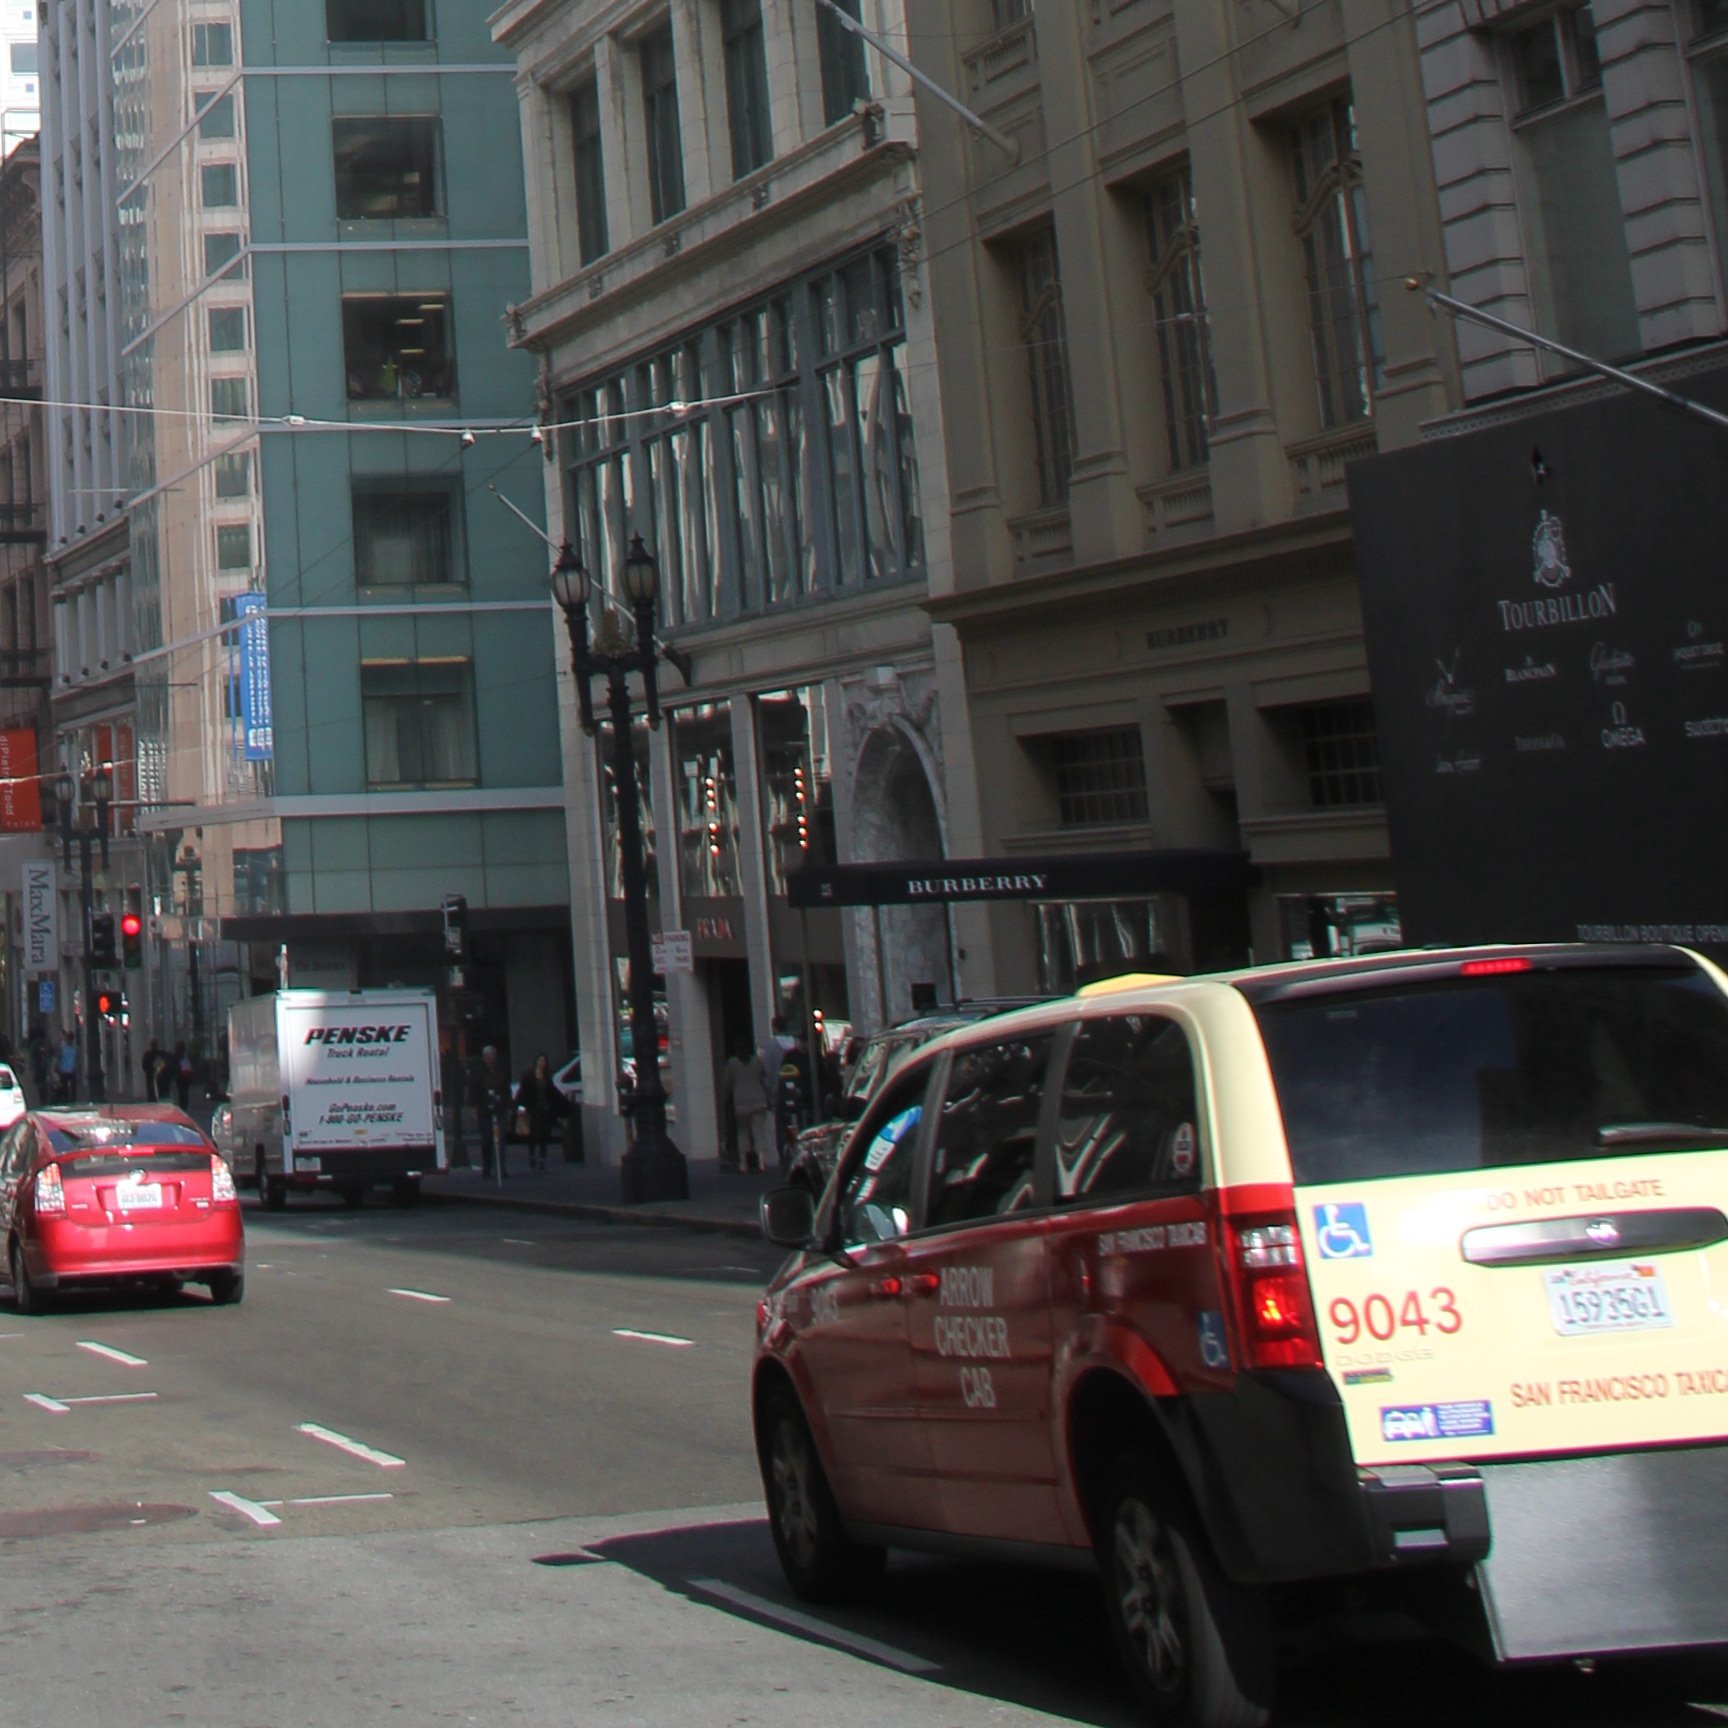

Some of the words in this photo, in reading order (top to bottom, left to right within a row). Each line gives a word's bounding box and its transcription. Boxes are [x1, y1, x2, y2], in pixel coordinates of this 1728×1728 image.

[1498, 582, 1618, 631] TOURBILLON
[1601, 727, 1646, 749] OMEGA
[907, 873, 1048, 895] BURBERRY
[28, 868, 52, 964] MaxMara
[1576, 924, 1639, 942] TOURBILLON
[1640, 925, 1693, 942] BOUTIQUE
[305, 1025, 411, 1045] PENSKE
[327, 1048, 354, 1058] Truck
[356, 1047, 389, 1058] Rental
[1487, 1191, 1517, 1211] DO
[1523, 1185, 1565, 1206] NOT
[1572, 1178, 1666, 1204] TAILGATE
[940, 1266, 994, 1308] ARROW
[1328, 1286, 1463, 1344] 9043
[933, 1316, 1011, 1359] CHECKER
[1335, 1347, 1435, 1367] DODGE
[959, 1366, 996, 1409] CAB
[1509, 1381, 1553, 1408] SAN
[1558, 1372, 1670, 1406] FRANCISCO
